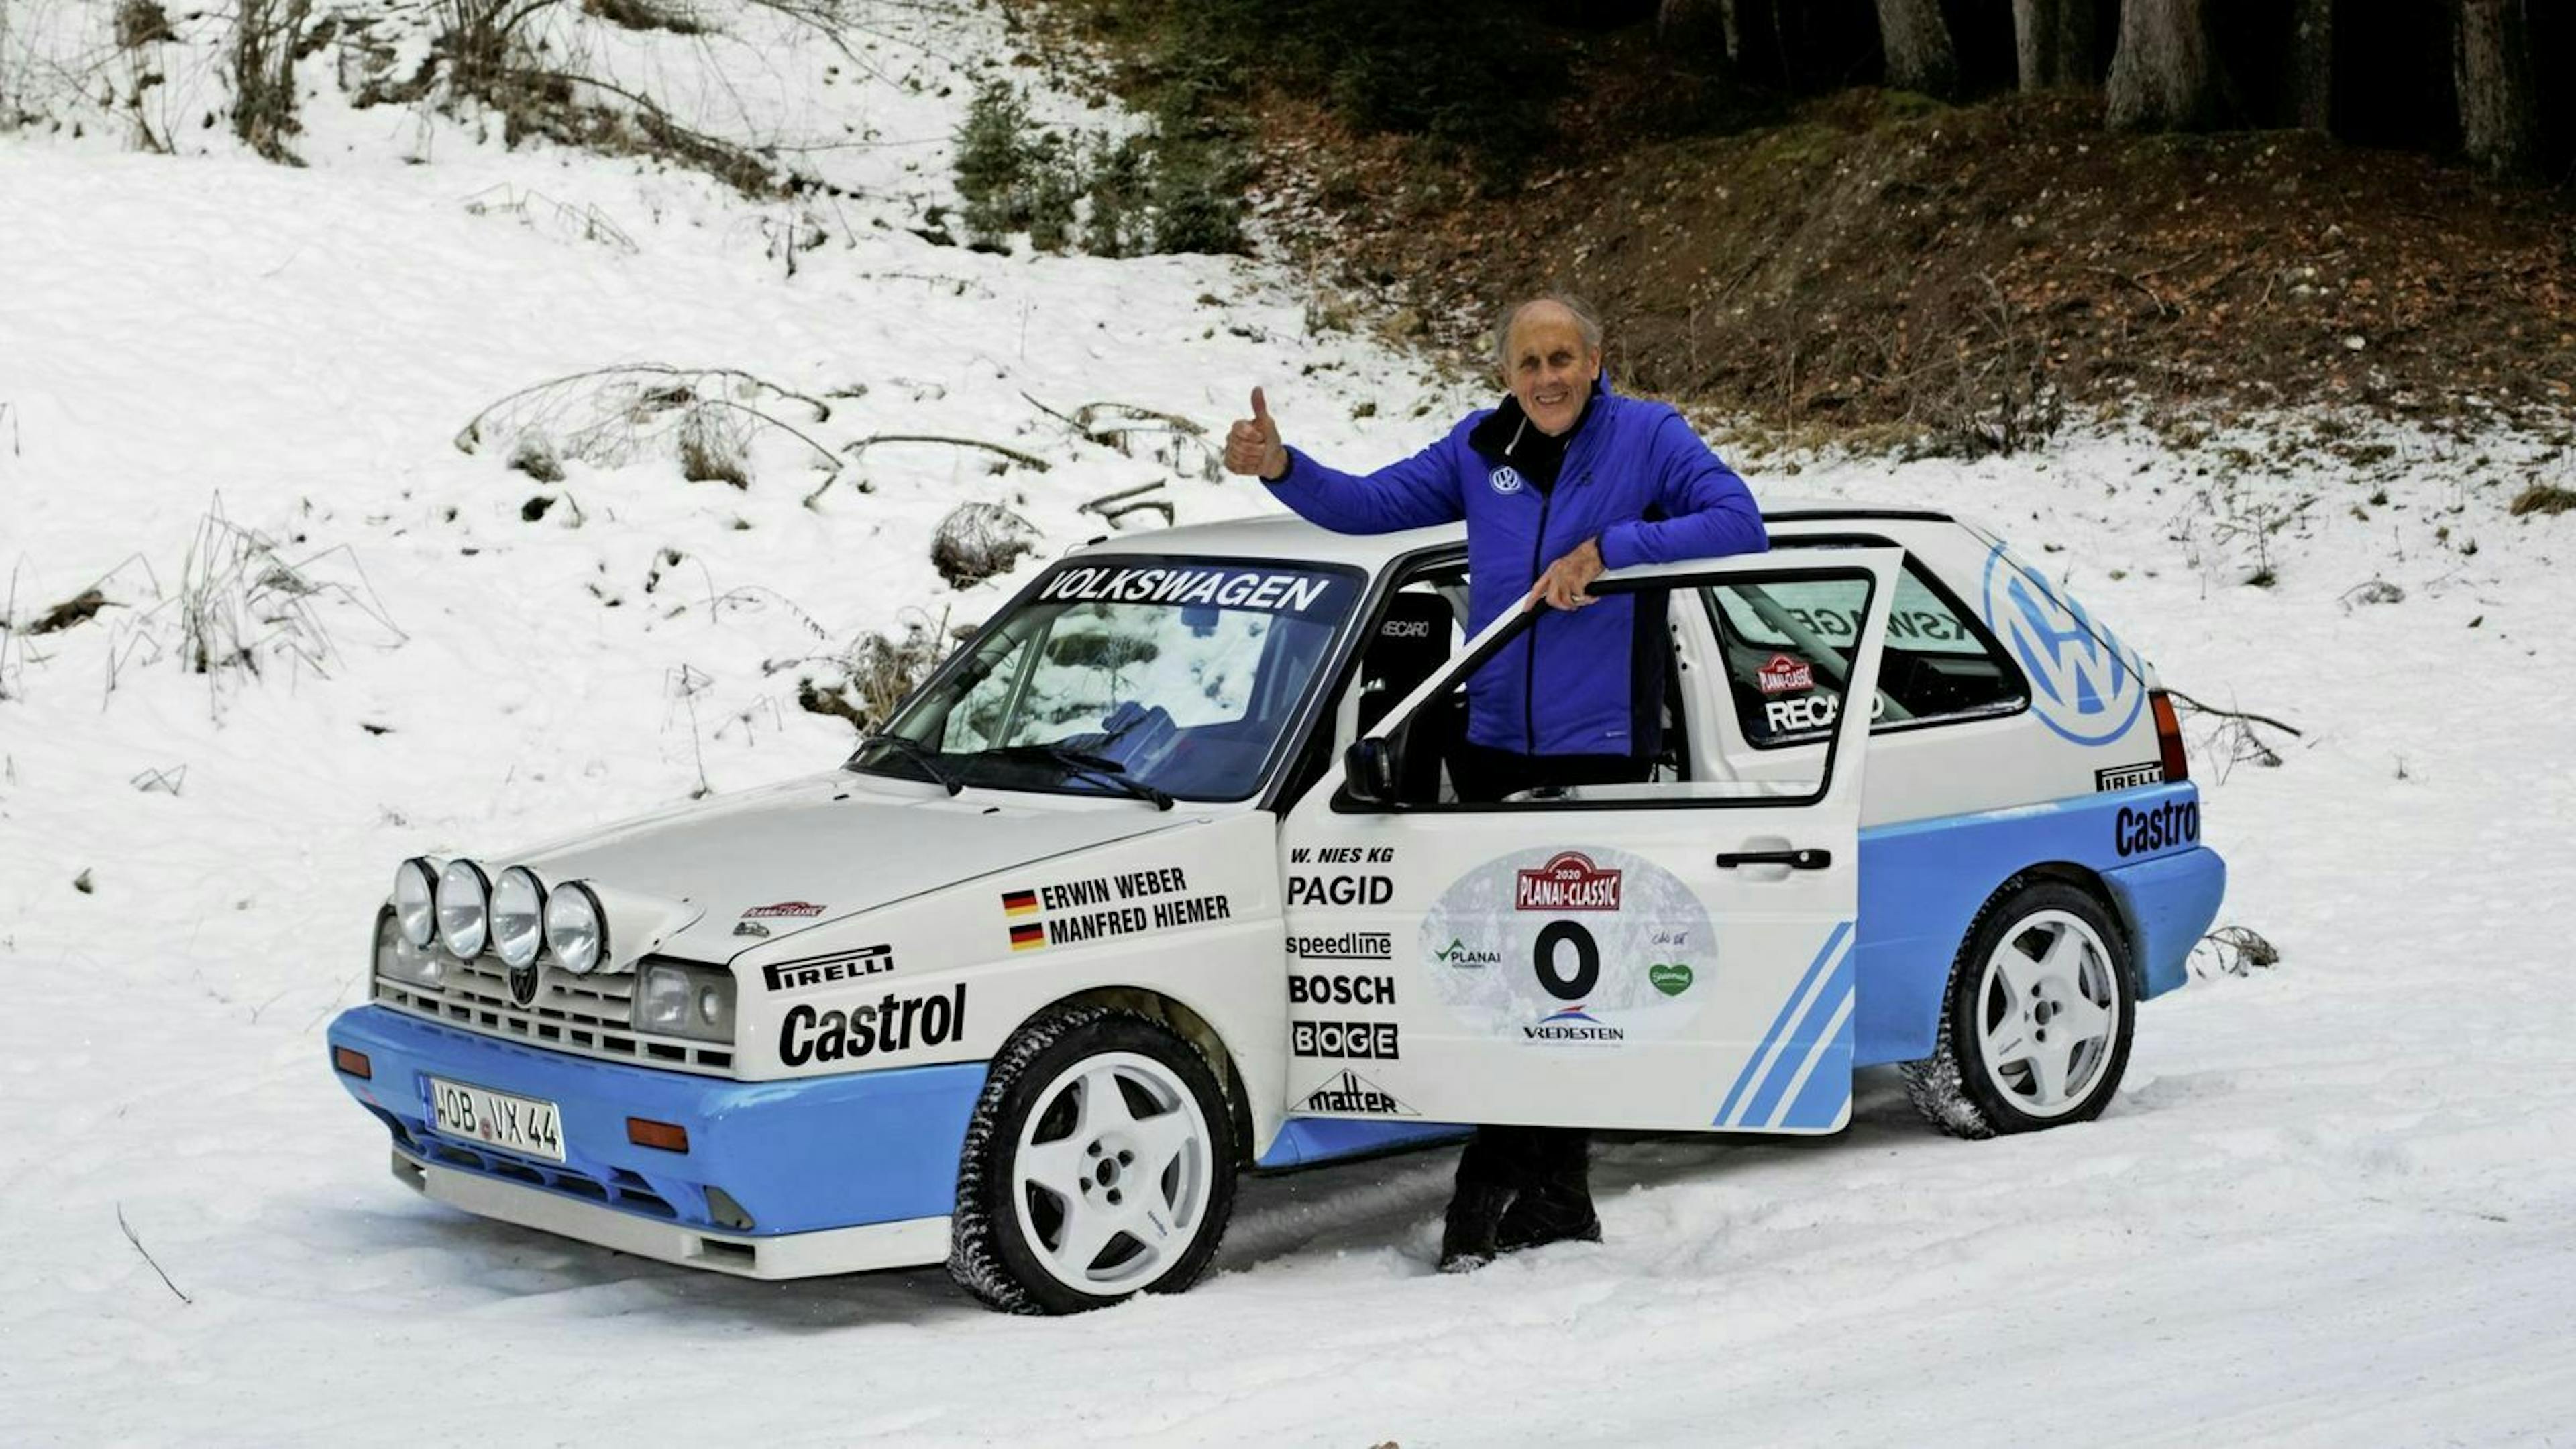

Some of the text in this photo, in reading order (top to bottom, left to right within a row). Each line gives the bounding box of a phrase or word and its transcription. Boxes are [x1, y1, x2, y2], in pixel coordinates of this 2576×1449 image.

[1039, 567, 1330, 612] VOLKSWAGEN
[2095, 761, 2163, 792] PIRELLI
[2116, 800, 2200, 857] Castro
[1291, 848, 1394, 863] W. NIES KG
[1042, 867, 1187, 910] ERWIN WEBER
[1288, 876, 1393, 905] PAGID
[1520, 875, 1617, 906] PLANAI-CLASSIC
[1555, 870, 1582, 880] 2020
[1049, 895, 1230, 945] MANFRED HIEMER
[1286, 933, 1391, 959] speedline
[1451, 951, 1501, 963] PLANAI
[1534, 920, 1599, 1000] 0
[762, 944, 894, 991] PIRELLI
[1288, 975, 1395, 1004] BOSCH
[780, 983, 966, 1066] Castrol
[1295, 1024, 1397, 1056] BOGE
[1523, 1027, 1623, 1040] VREDESTEIN
[433, 1082, 557, 1151] WOB VX 44
